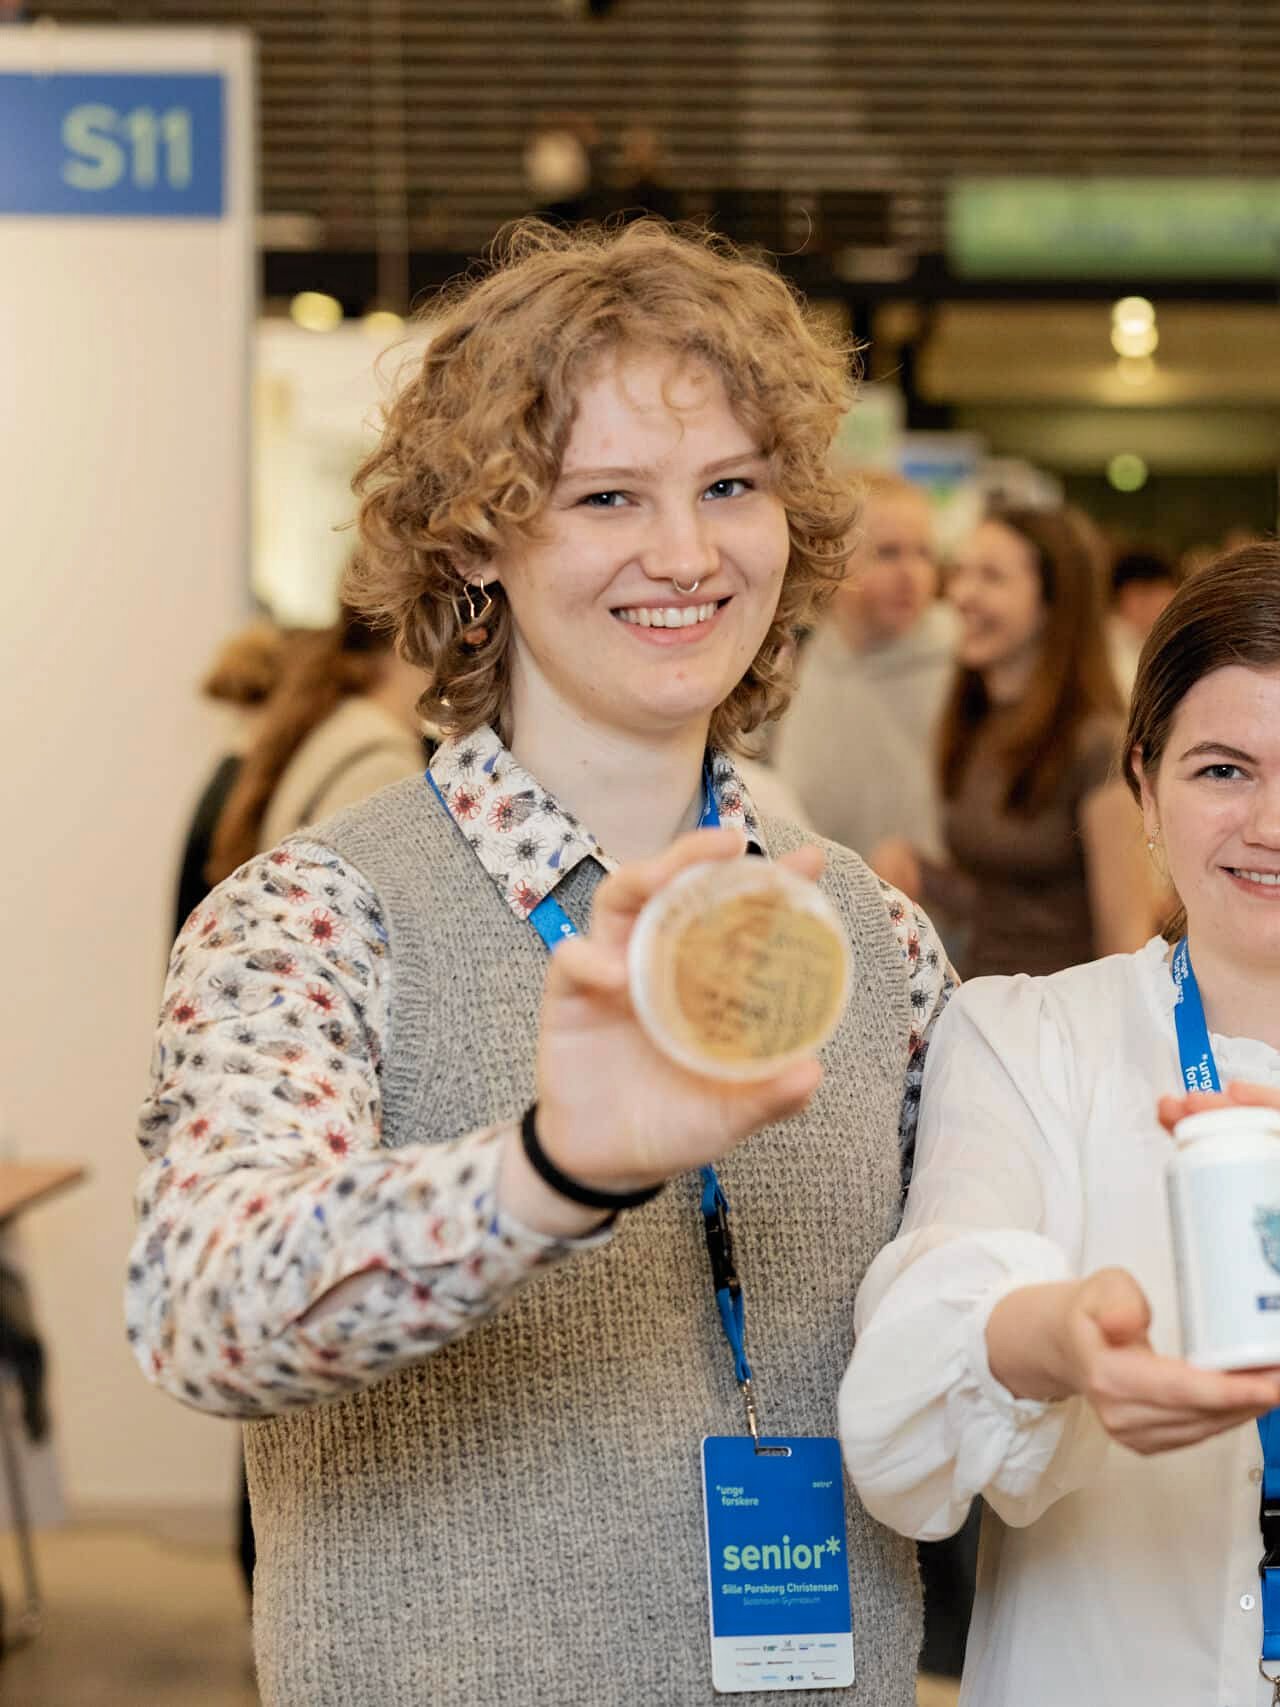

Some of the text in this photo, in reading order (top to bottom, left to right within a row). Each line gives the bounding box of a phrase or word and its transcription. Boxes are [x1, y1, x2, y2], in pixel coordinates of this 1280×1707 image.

[61, 103, 192, 189] S11
[721, 1495, 760, 1507] forskere
[786, 1582, 840, 1593] Christensen
